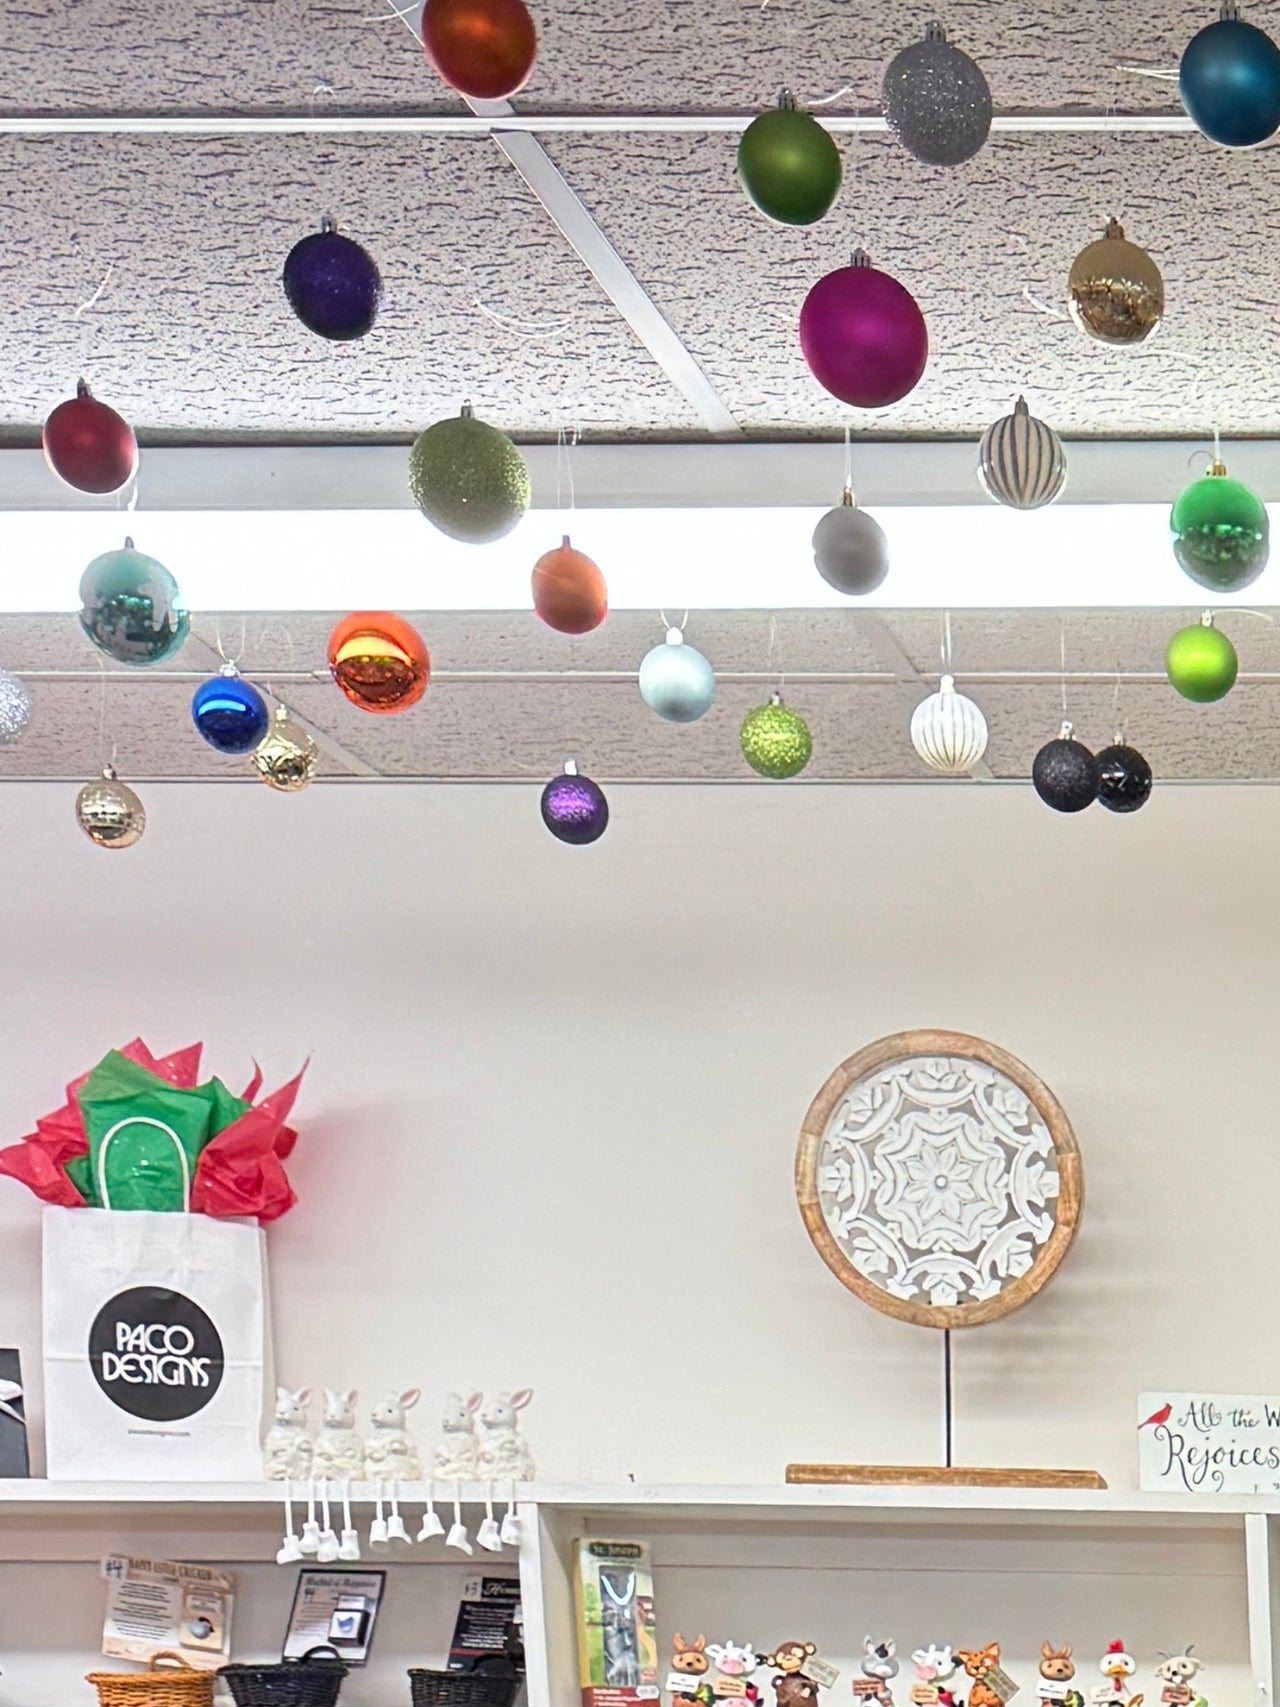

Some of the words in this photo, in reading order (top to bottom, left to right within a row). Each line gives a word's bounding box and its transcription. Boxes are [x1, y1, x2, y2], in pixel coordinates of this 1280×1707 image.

[115, 1321, 195, 1356] PACO
[101, 1351, 211, 1387] DESIGNS
[1178, 1401, 1222, 1433] All
[1227, 1408, 1260, 1428] the
[1153, 1424, 1280, 1492] Rejoices
